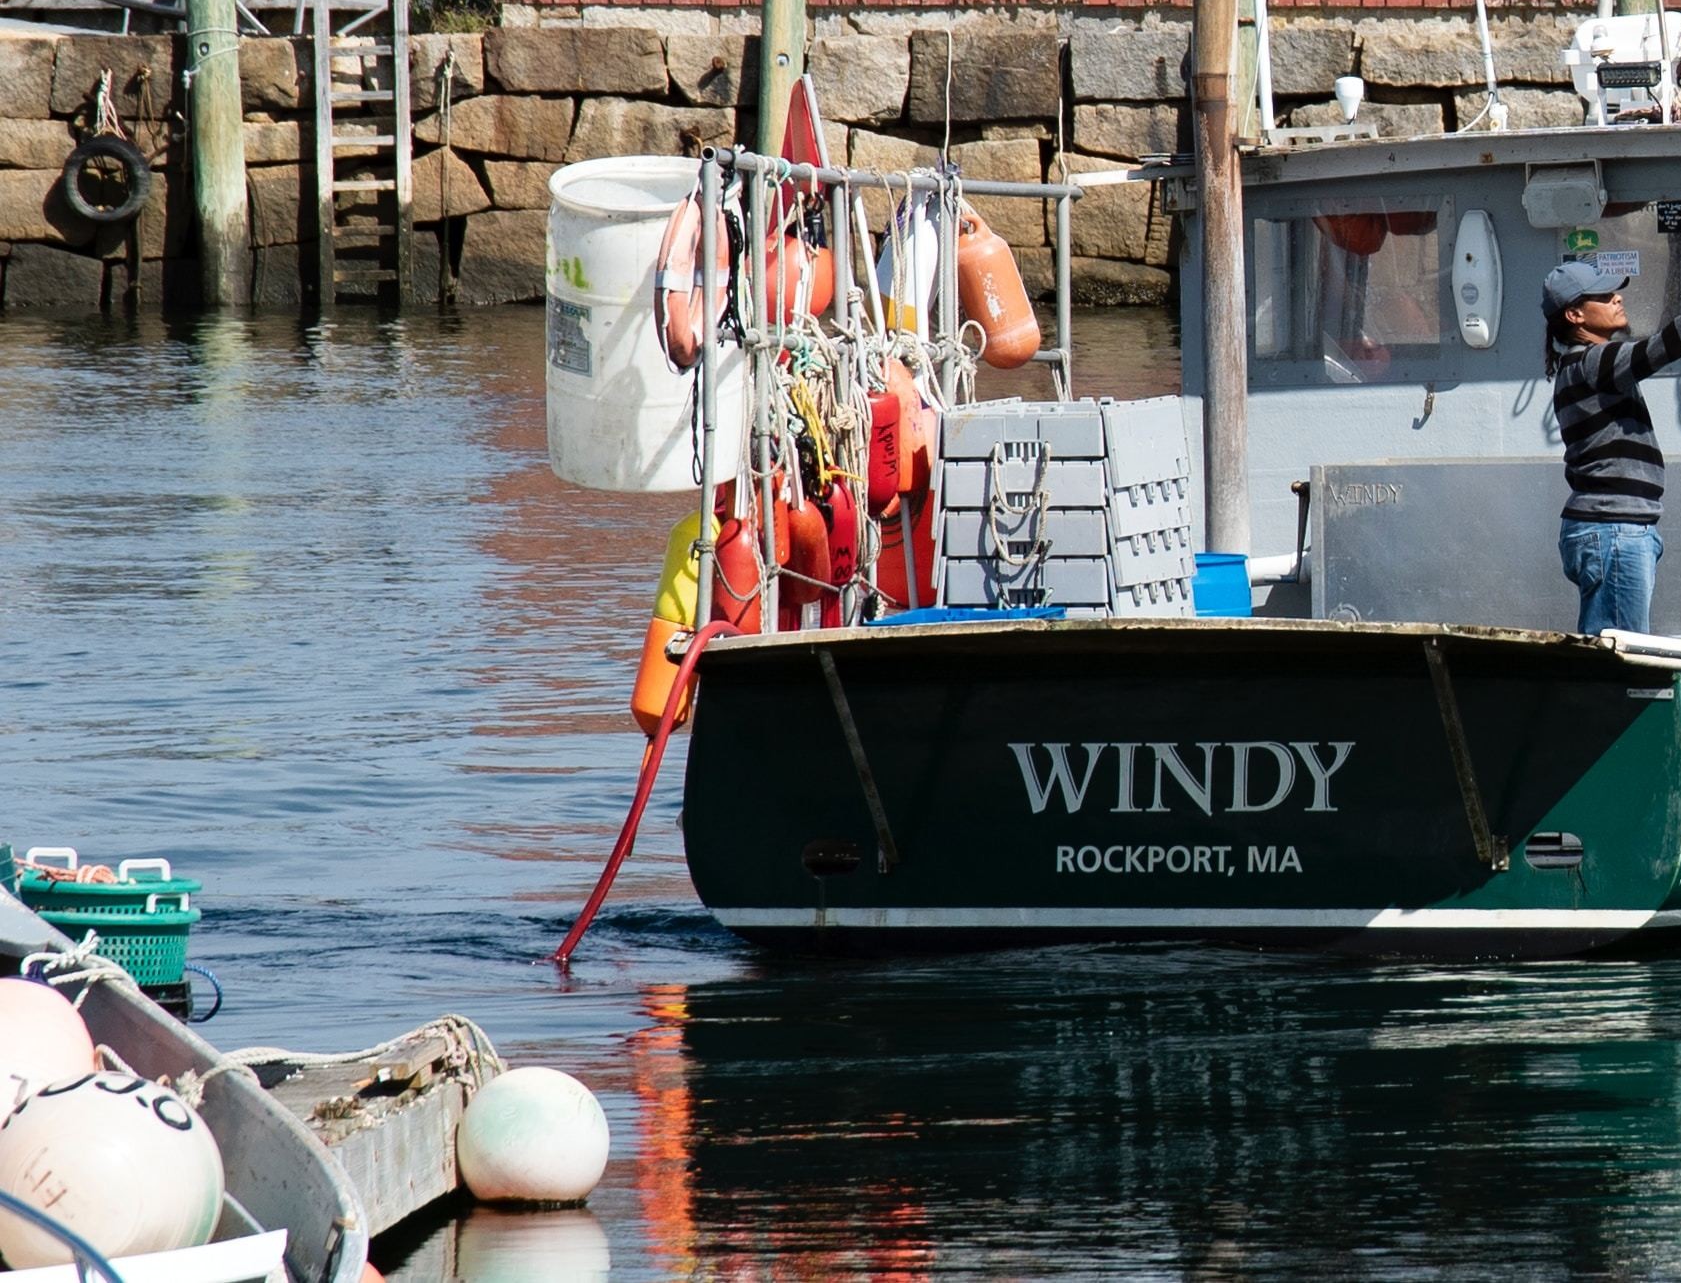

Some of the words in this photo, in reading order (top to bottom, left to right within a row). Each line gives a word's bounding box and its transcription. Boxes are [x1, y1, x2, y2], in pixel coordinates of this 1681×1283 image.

[1599, 252, 1637, 261] PATRIOTISM
[1328, 483, 1404, 507] WINDY
[1007, 741, 1356, 817] WINDY
[1056, 844, 1236, 877] ROCKPORT,
[1247, 845, 1303, 873] MA
